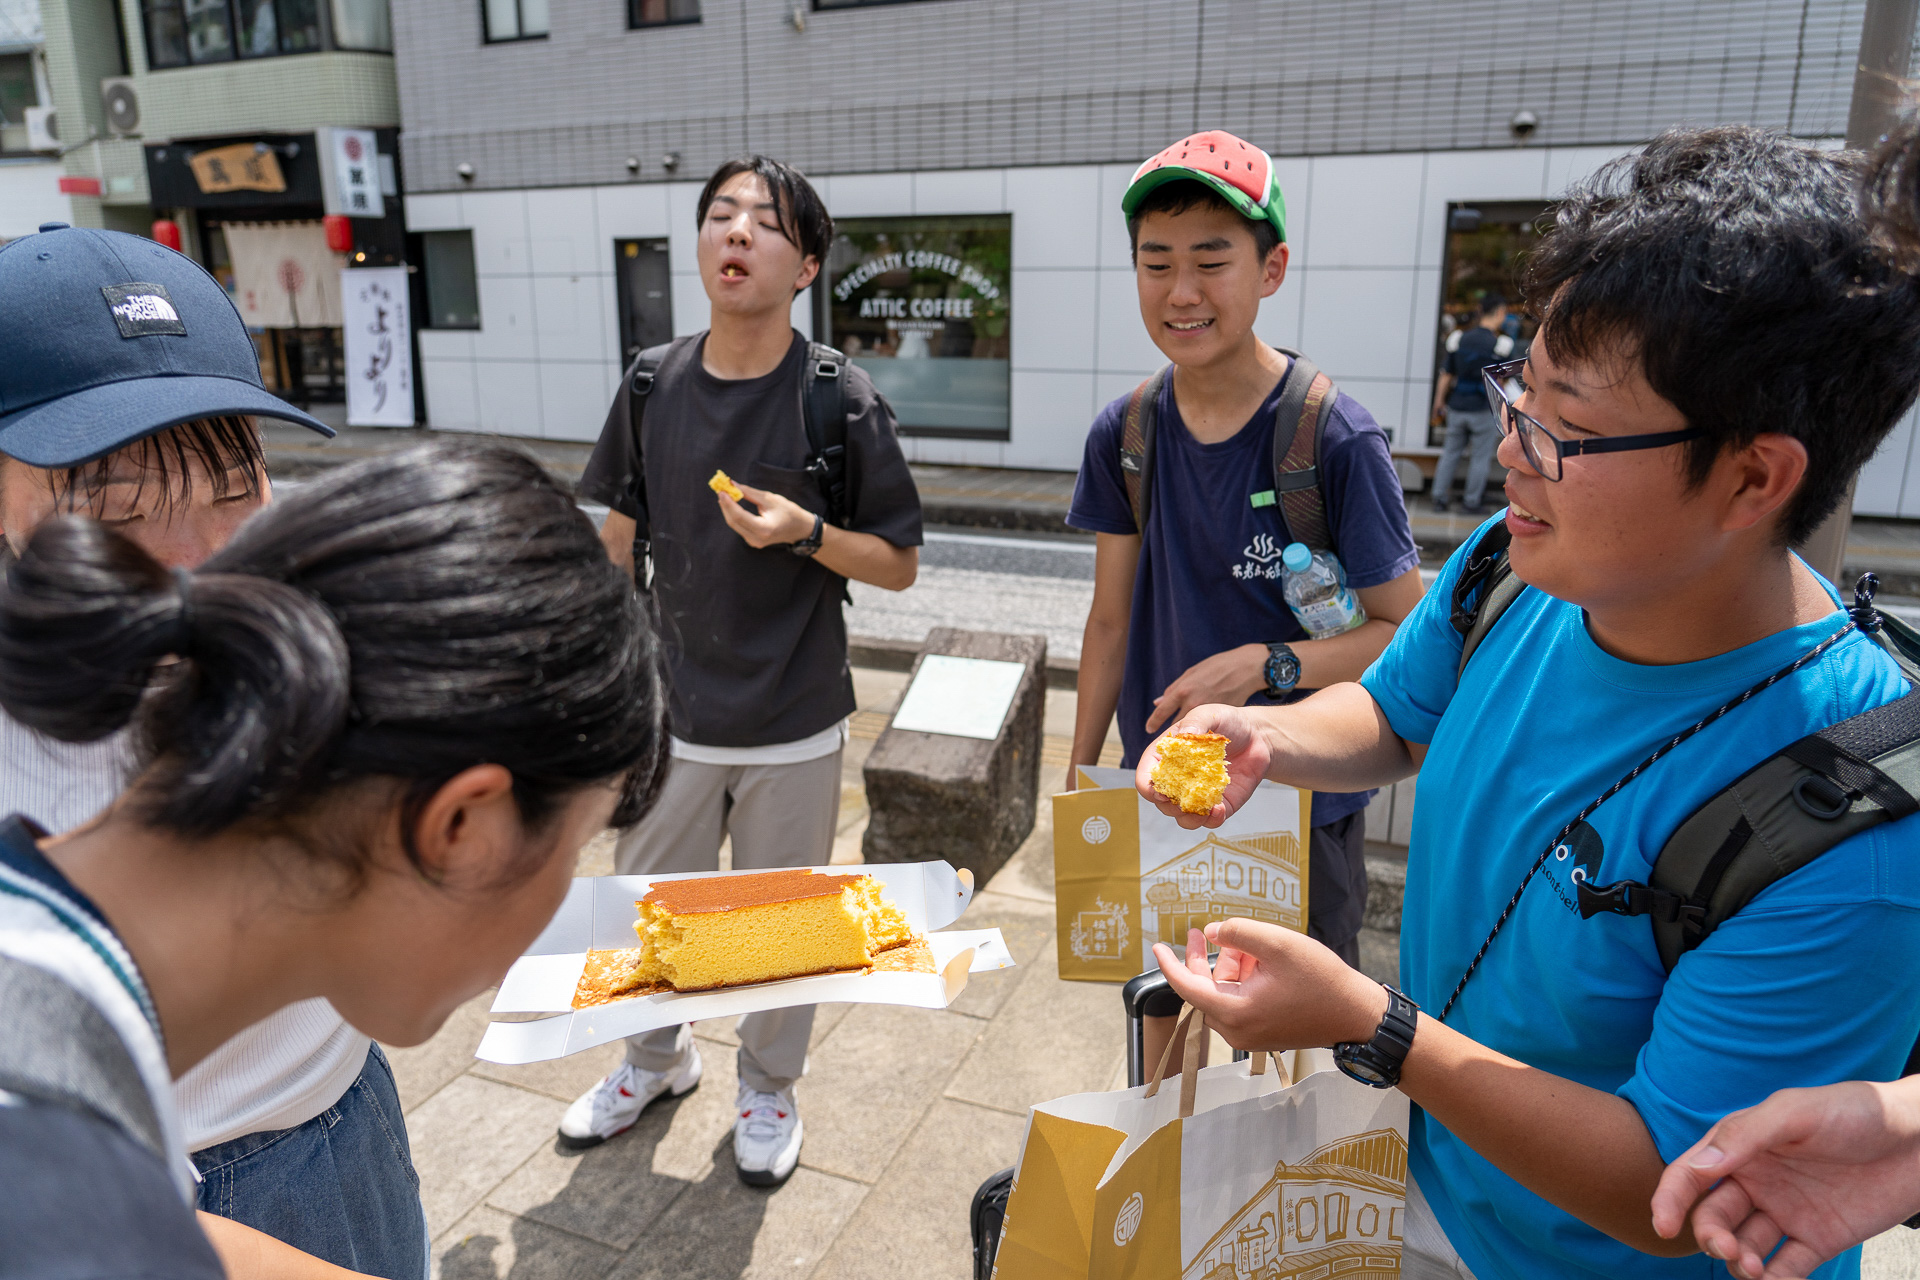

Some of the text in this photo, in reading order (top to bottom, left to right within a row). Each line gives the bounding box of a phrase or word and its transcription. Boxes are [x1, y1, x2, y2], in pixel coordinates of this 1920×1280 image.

[834, 250, 999, 301] SPECIALTY COFFEE SHOP
[126, 295, 154, 304] THE
[112, 303, 157, 316] NORTH
[860, 298, 973, 318] ATTIC COFFEE
[127, 310, 161, 321] FACE
